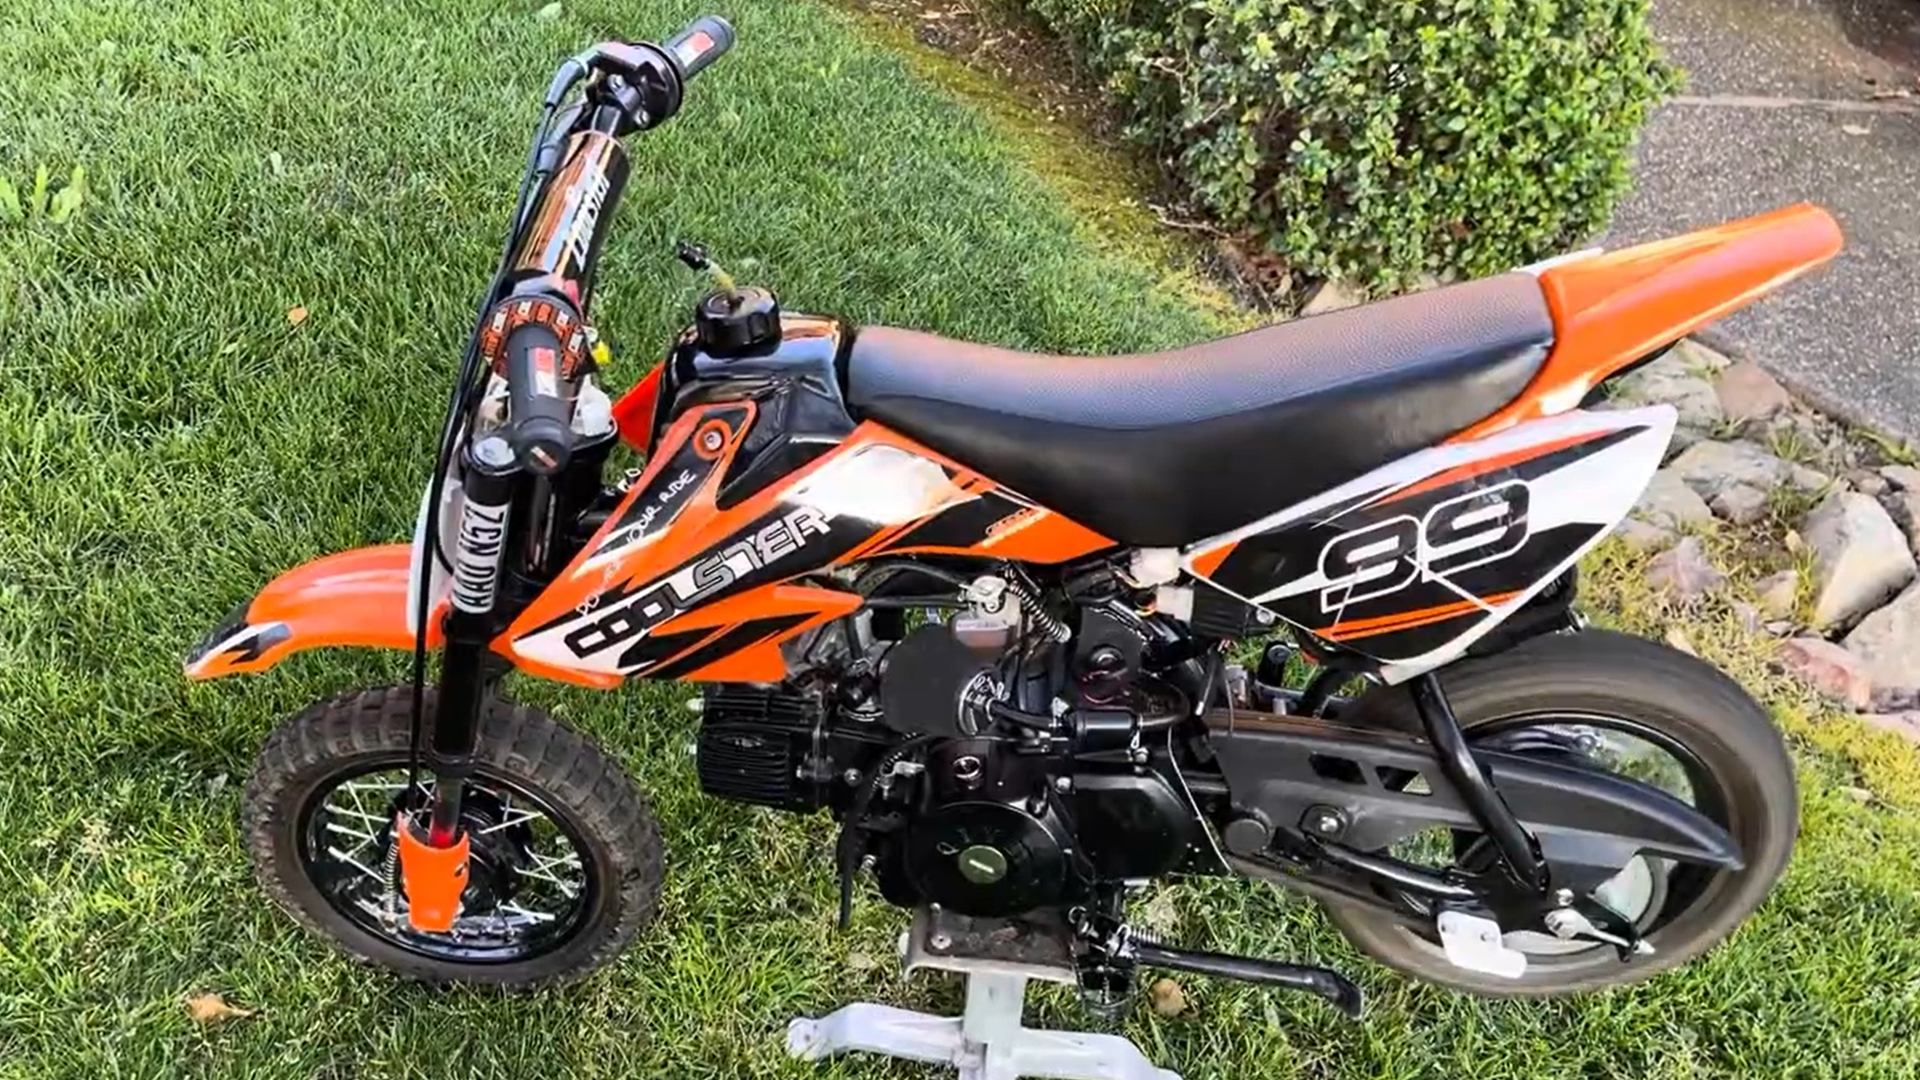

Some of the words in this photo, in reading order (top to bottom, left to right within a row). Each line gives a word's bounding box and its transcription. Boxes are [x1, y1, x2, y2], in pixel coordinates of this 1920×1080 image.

[659, 469, 697, 504] RIDE
[1318, 479, 1531, 614] 99
[564, 504, 831, 660] COOLSTER
